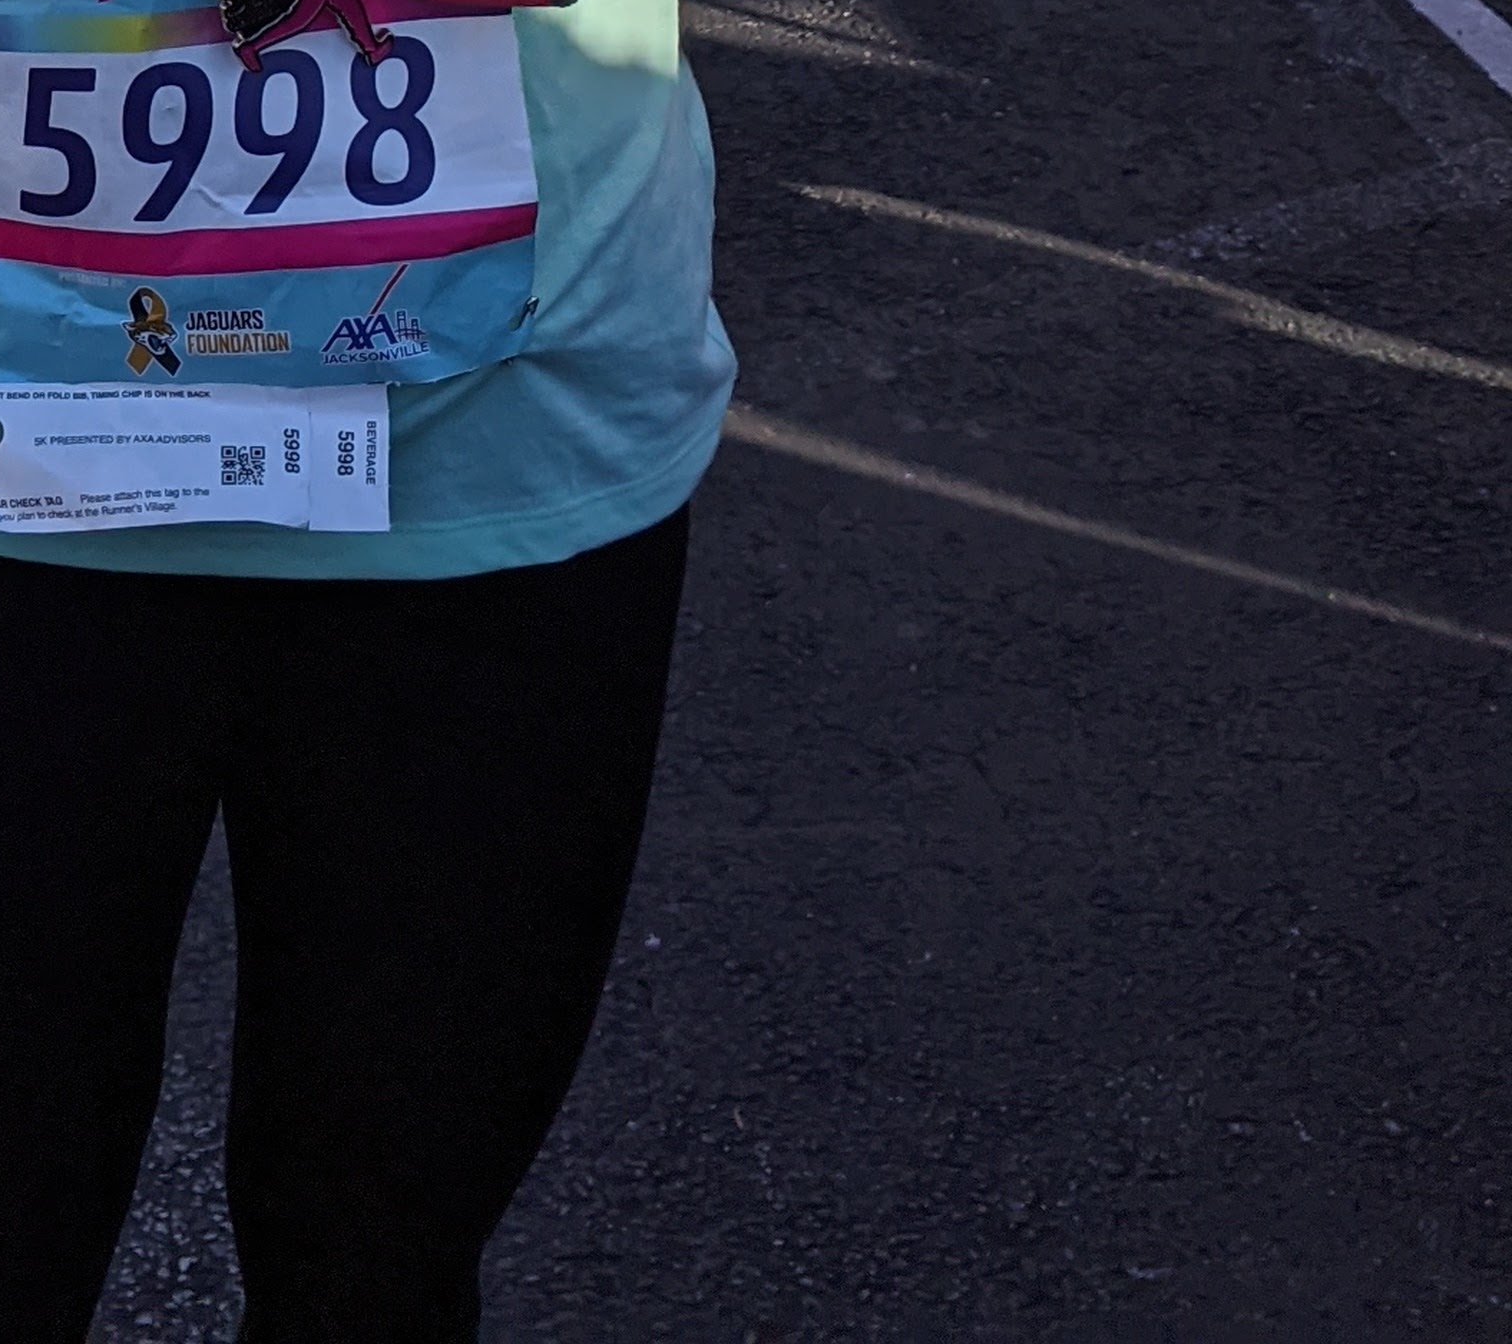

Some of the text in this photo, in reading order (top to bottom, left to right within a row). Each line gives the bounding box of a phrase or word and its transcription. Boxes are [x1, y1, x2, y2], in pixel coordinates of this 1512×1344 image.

[19, 36, 436, 222] 5998
[185, 310, 264, 330] JAGUARS
[185, 332, 291, 354] FOUNDATION
[321, 313, 397, 353] AXA
[323, 342, 429, 364] JACKSONVILLE
[91, 391, 119, 399] TIMING
[122, 390, 141, 398] CHIP
[144, 390, 152, 398] IS
[155, 390, 167, 398] ON
[169, 390, 185, 398] THE
[187, 390, 211, 398] BACK
[34, 436, 47, 446] 5K
[50, 435, 114, 445] PRESENTED
[116, 435, 131, 444] BY
[156, 434, 212, 444] ADVISORS
[283, 428, 301, 474] 5998
[337, 430, 355, 476] 5998
[365, 420, 377, 486] BEVERAGE
[9, 496, 41, 508] CHECK
[45, 496, 63, 506] TAG
[80, 493, 111, 504] Please
[113, 491, 142, 501] attach
[145, 489, 161, 499] this
[164, 488, 180, 499] tag
[182, 488, 192, 496] to
[194, 488, 209, 496] the
[17, 511, 35, 522] plan
[37, 510, 46, 519] to
[47, 509, 73, 519] check
[85, 508, 99, 517] the
[101, 504, 142, 516] Runner's
[144, 501, 178, 513] Village.
